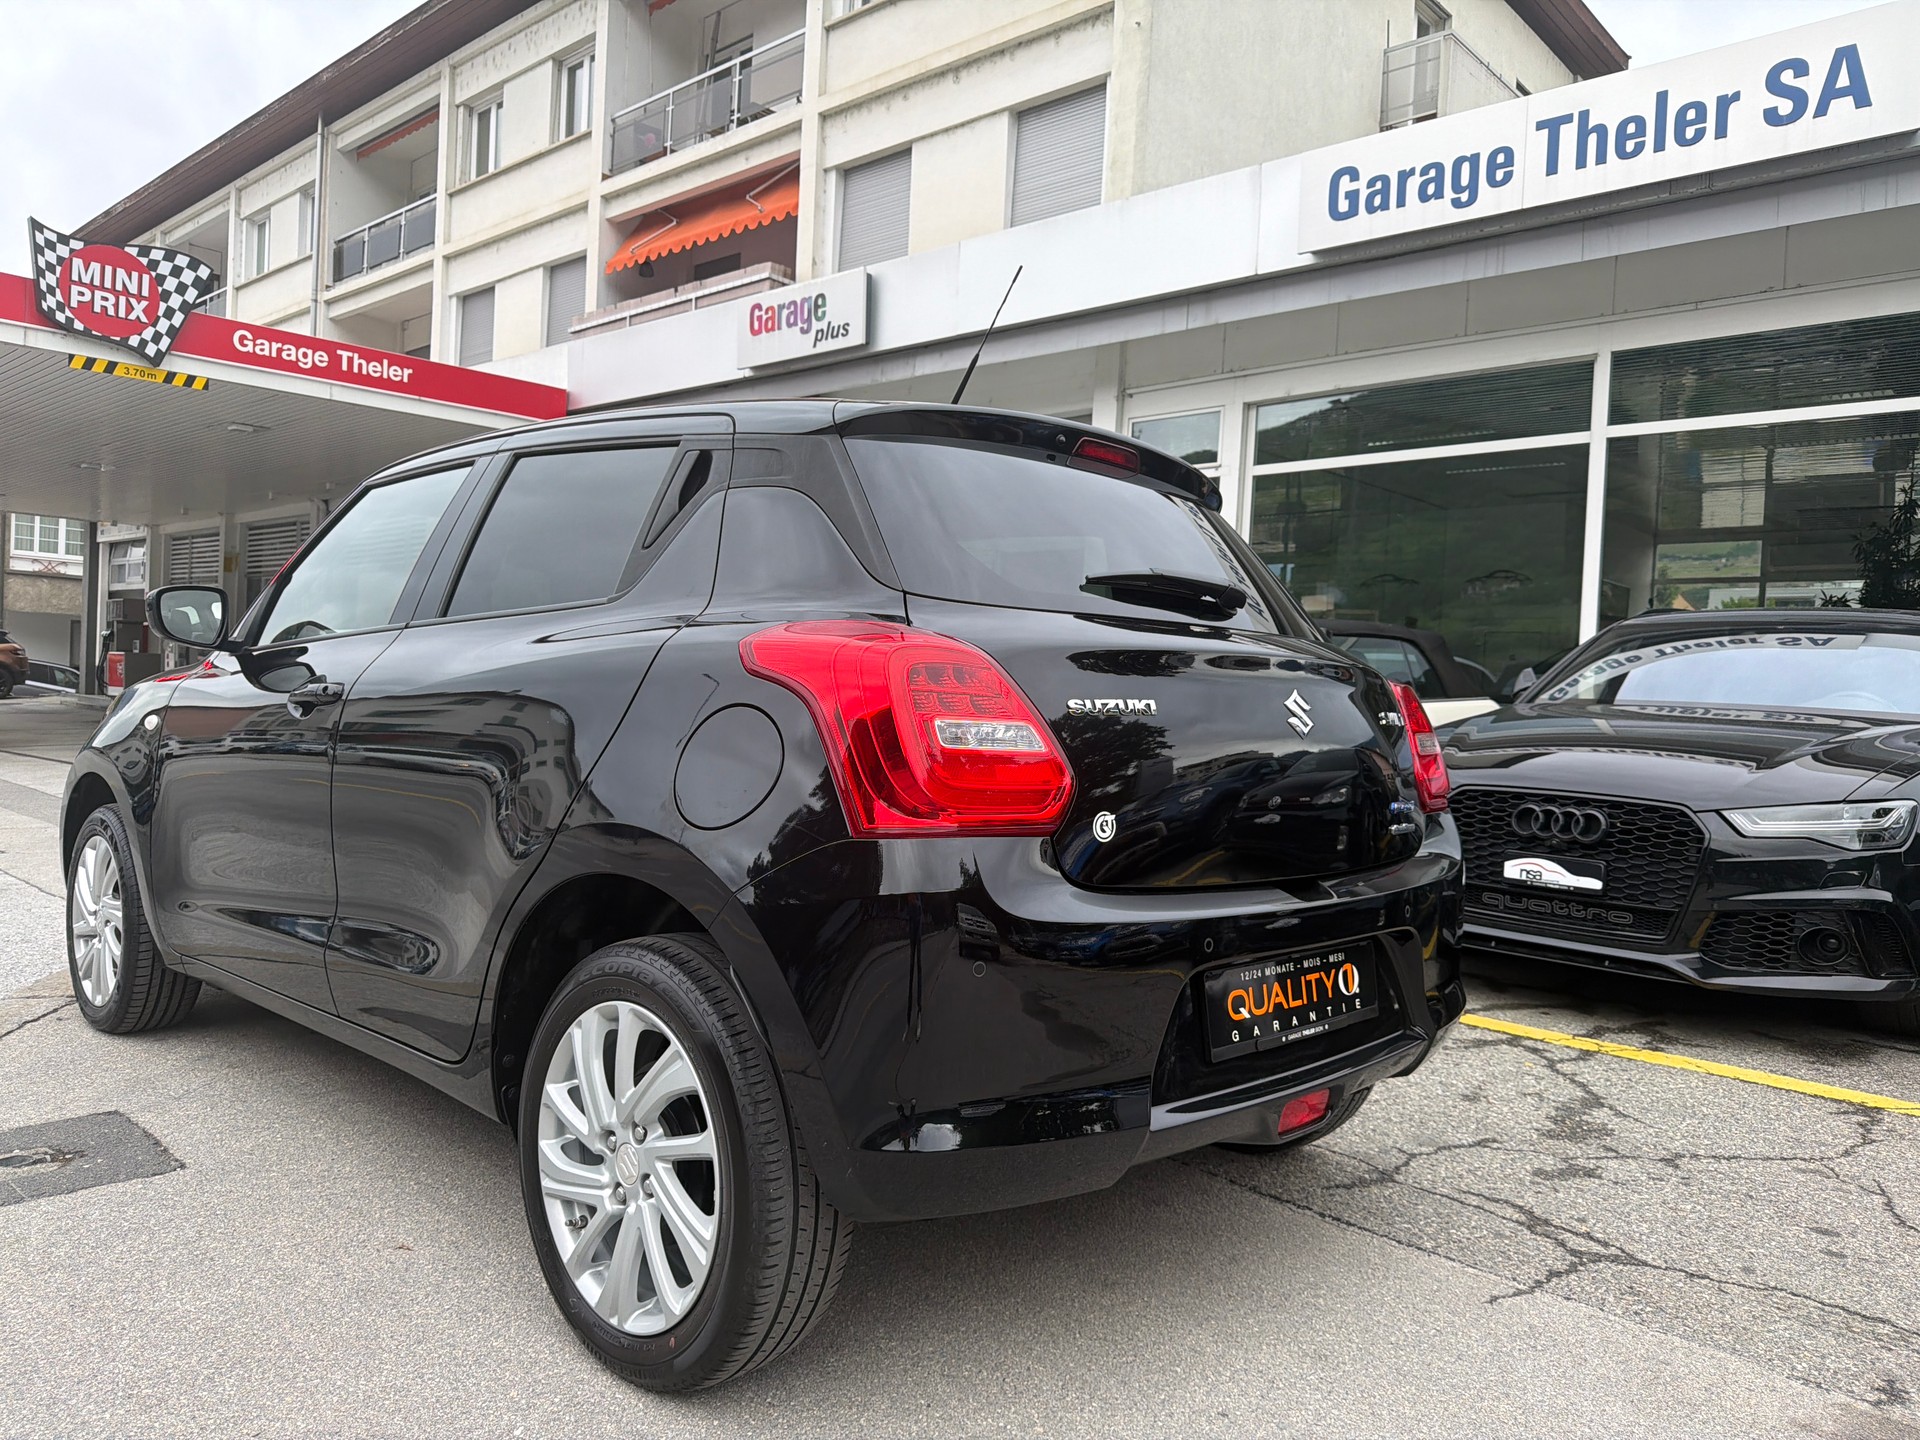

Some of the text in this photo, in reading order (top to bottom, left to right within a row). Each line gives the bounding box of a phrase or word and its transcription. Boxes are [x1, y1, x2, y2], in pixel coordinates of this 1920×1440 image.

[1327, 43, 1873, 222] Garage Theler SA
[71, 256, 150, 298] MINI
[69, 284, 150, 324] PRIX
[749, 292, 828, 337] Garage
[812, 320, 851, 349] plus
[123, 366, 157, 380] 3.70 m
[232, 329, 414, 383] Garage Theler
[1066, 698, 1158, 717] SUZUKI
[1519, 868, 1542, 881] nsa
[1481, 891, 1634, 925] quattro
[1240, 970, 1262, 982] 12/24
[1264, 963, 1295, 977] MONATE
[1303, 955, 1321, 969] MOIS
[1329, 952, 1345, 963] MESI
[1227, 968, 1336, 1021] QUALITY
[1231, 998, 1362, 1042] GARANTIE
